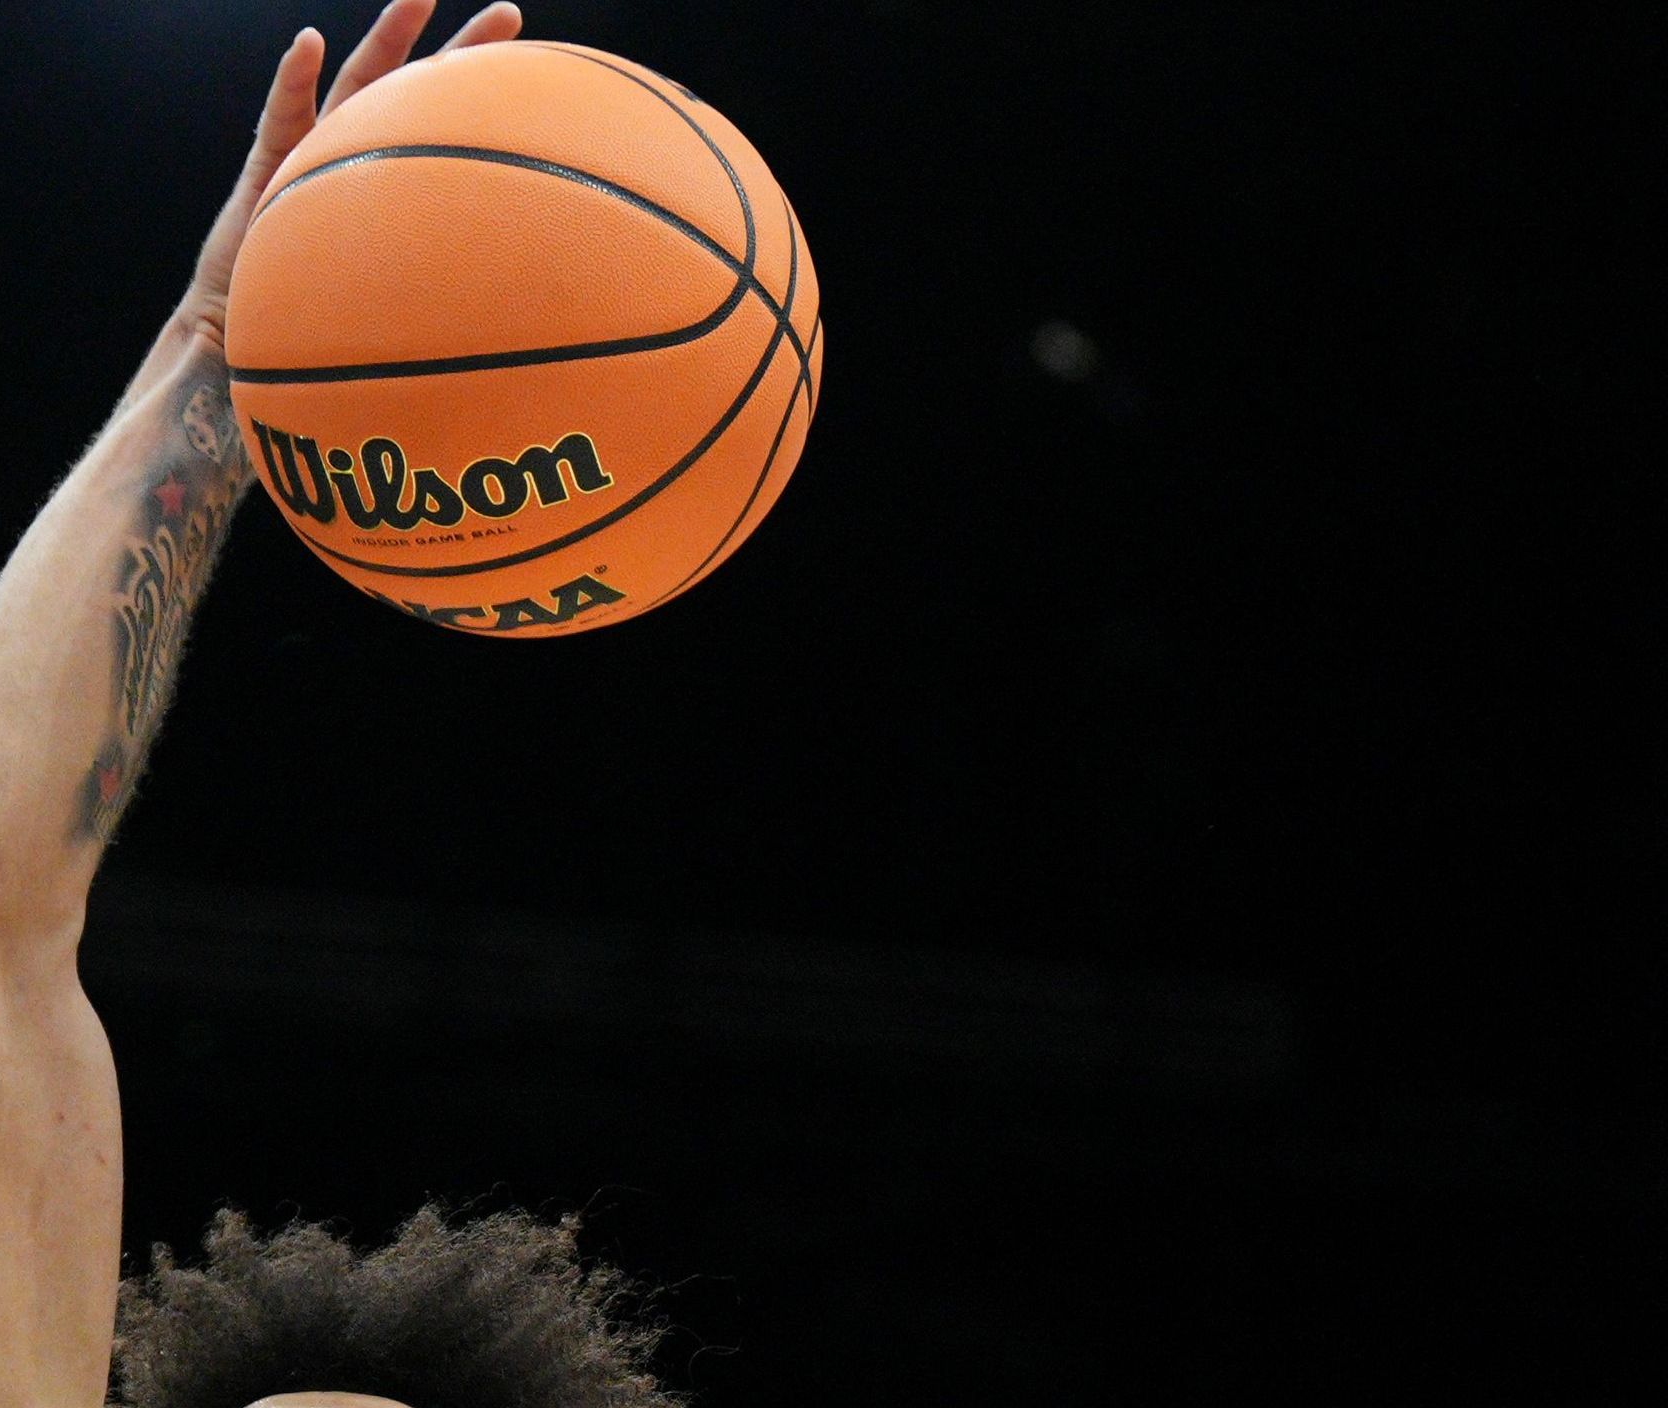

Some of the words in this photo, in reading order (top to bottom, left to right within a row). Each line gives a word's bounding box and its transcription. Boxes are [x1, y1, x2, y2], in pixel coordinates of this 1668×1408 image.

[251, 417, 613, 531] Wilson
[352, 535, 409, 547] INDOOR
[415, 533, 465, 546] GAME
[471, 525, 517, 539] BALL
